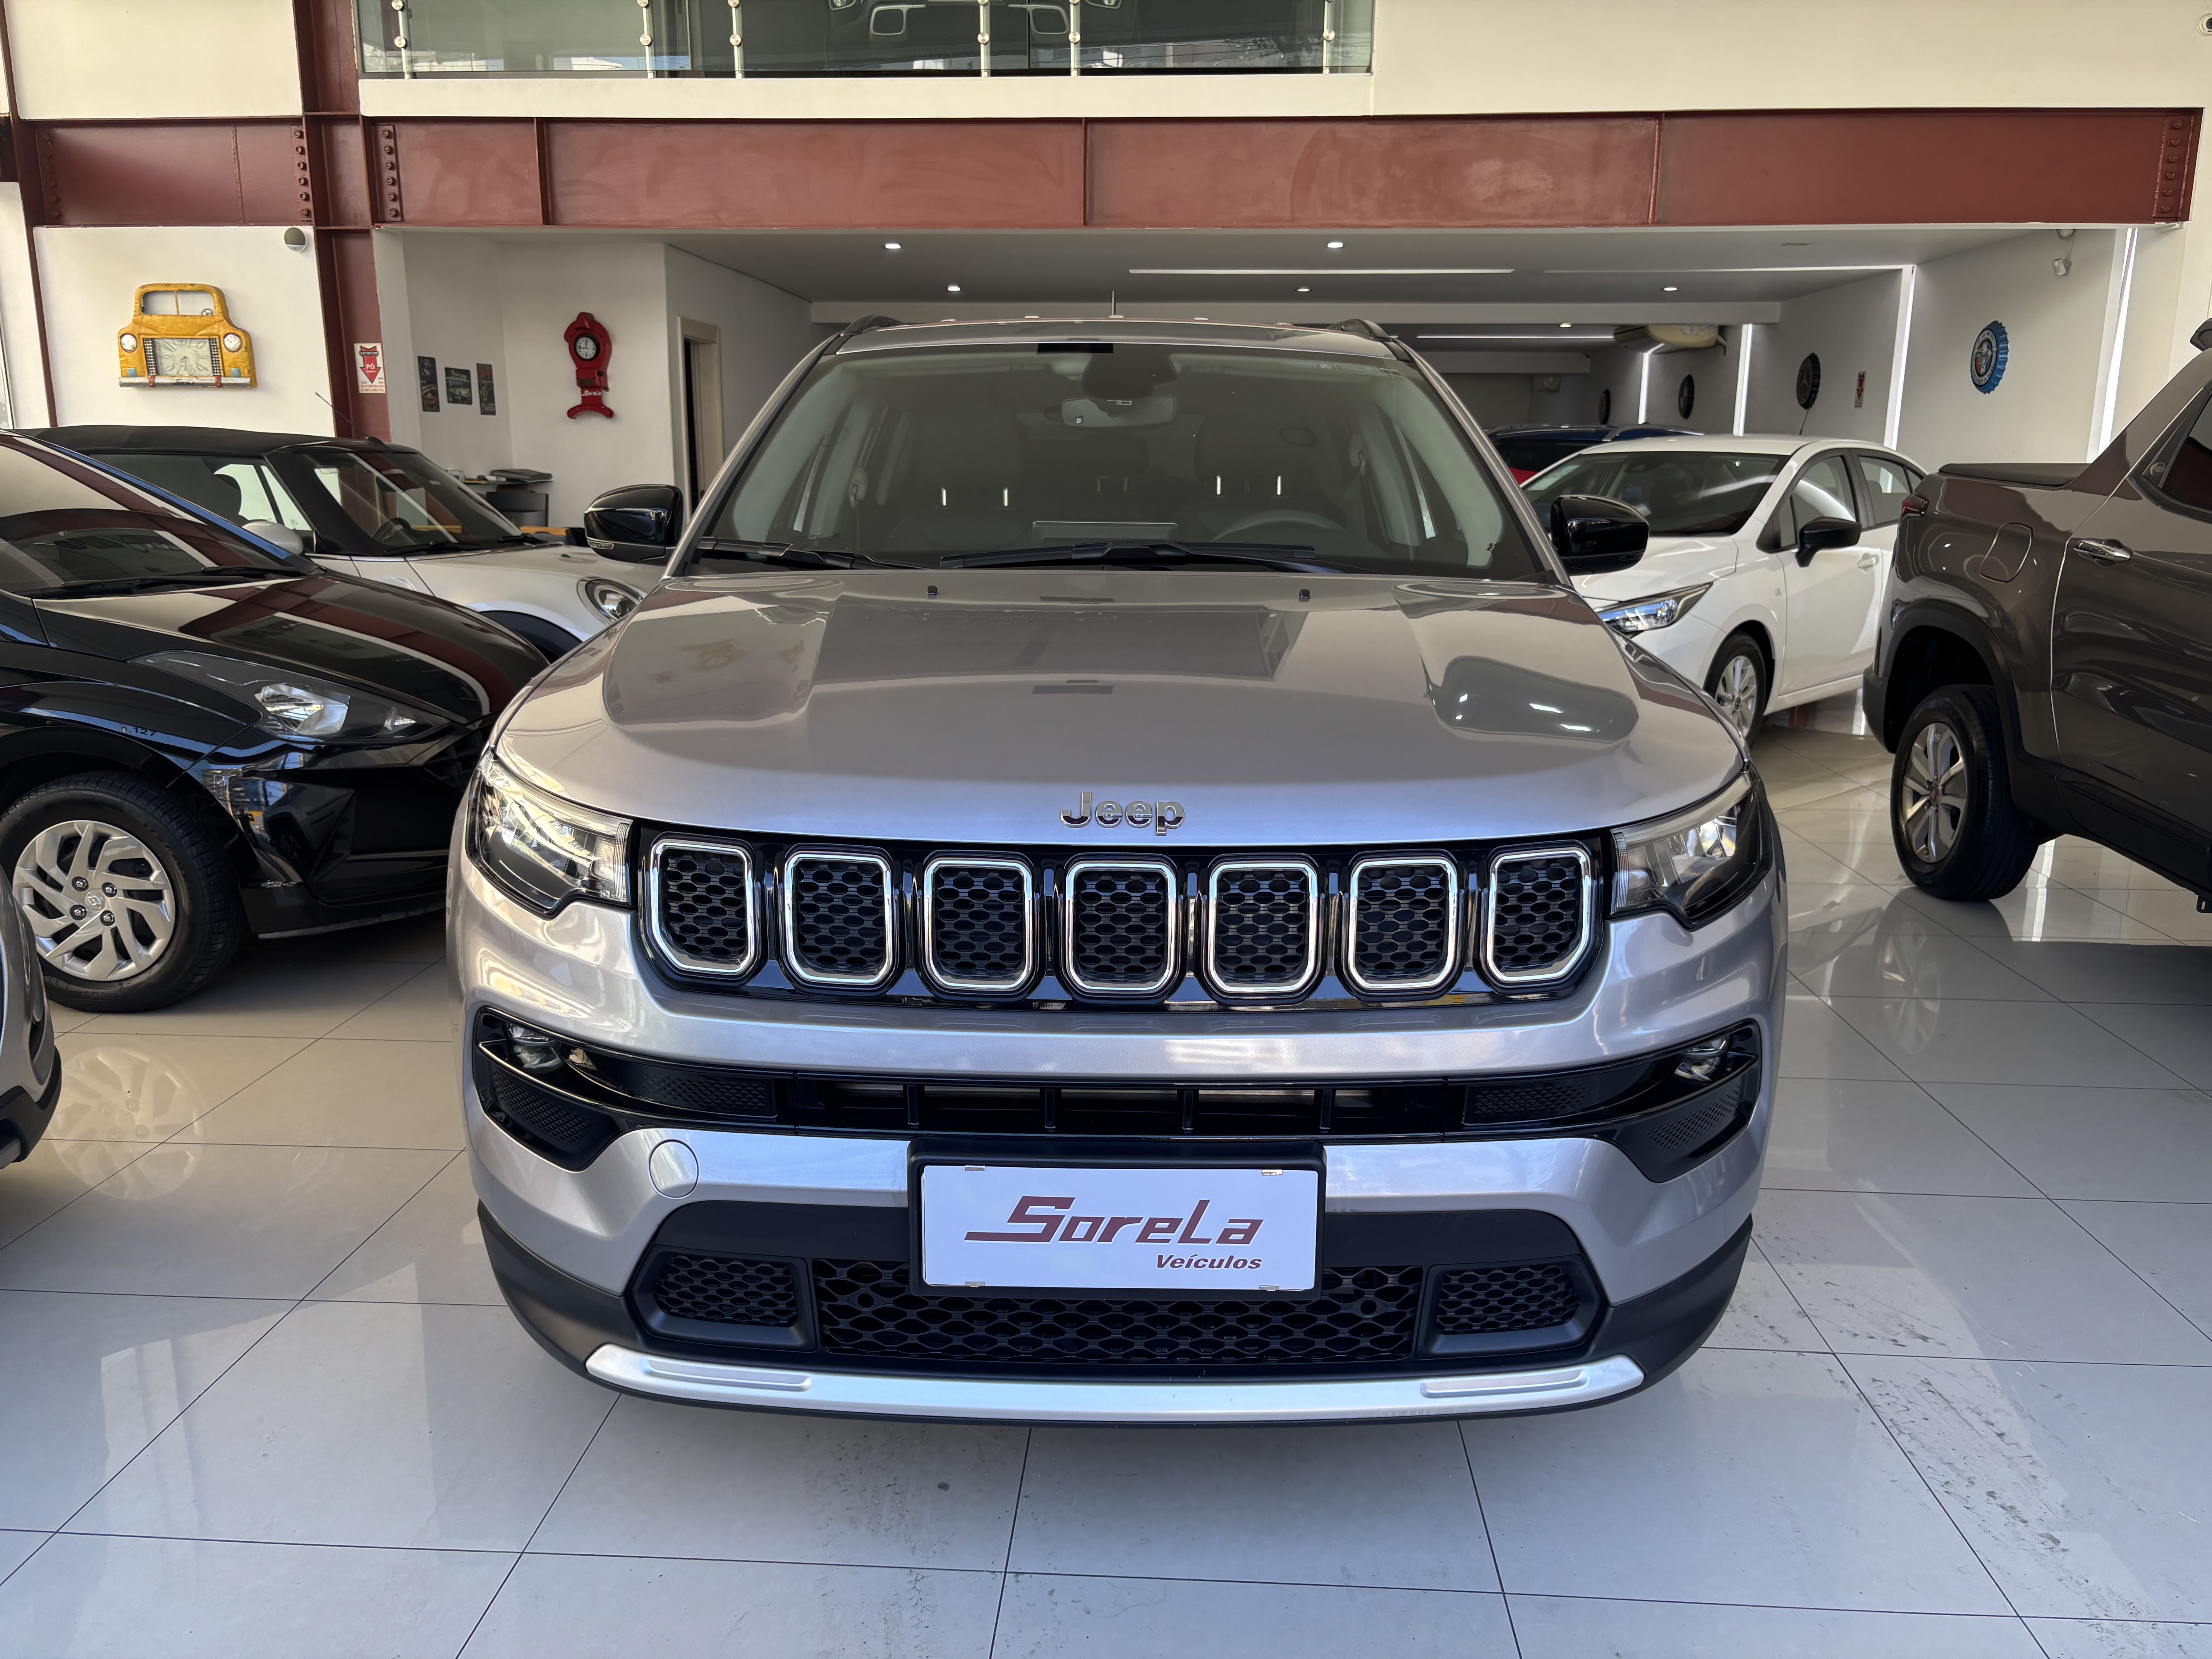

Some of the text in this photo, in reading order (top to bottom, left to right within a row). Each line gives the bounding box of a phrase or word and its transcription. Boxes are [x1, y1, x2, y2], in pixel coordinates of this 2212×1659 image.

[1977, 331, 1994, 343] FORD
[1060, 792, 1185, 836] Jeep
[1157, 1253, 1262, 1269] Veículos
